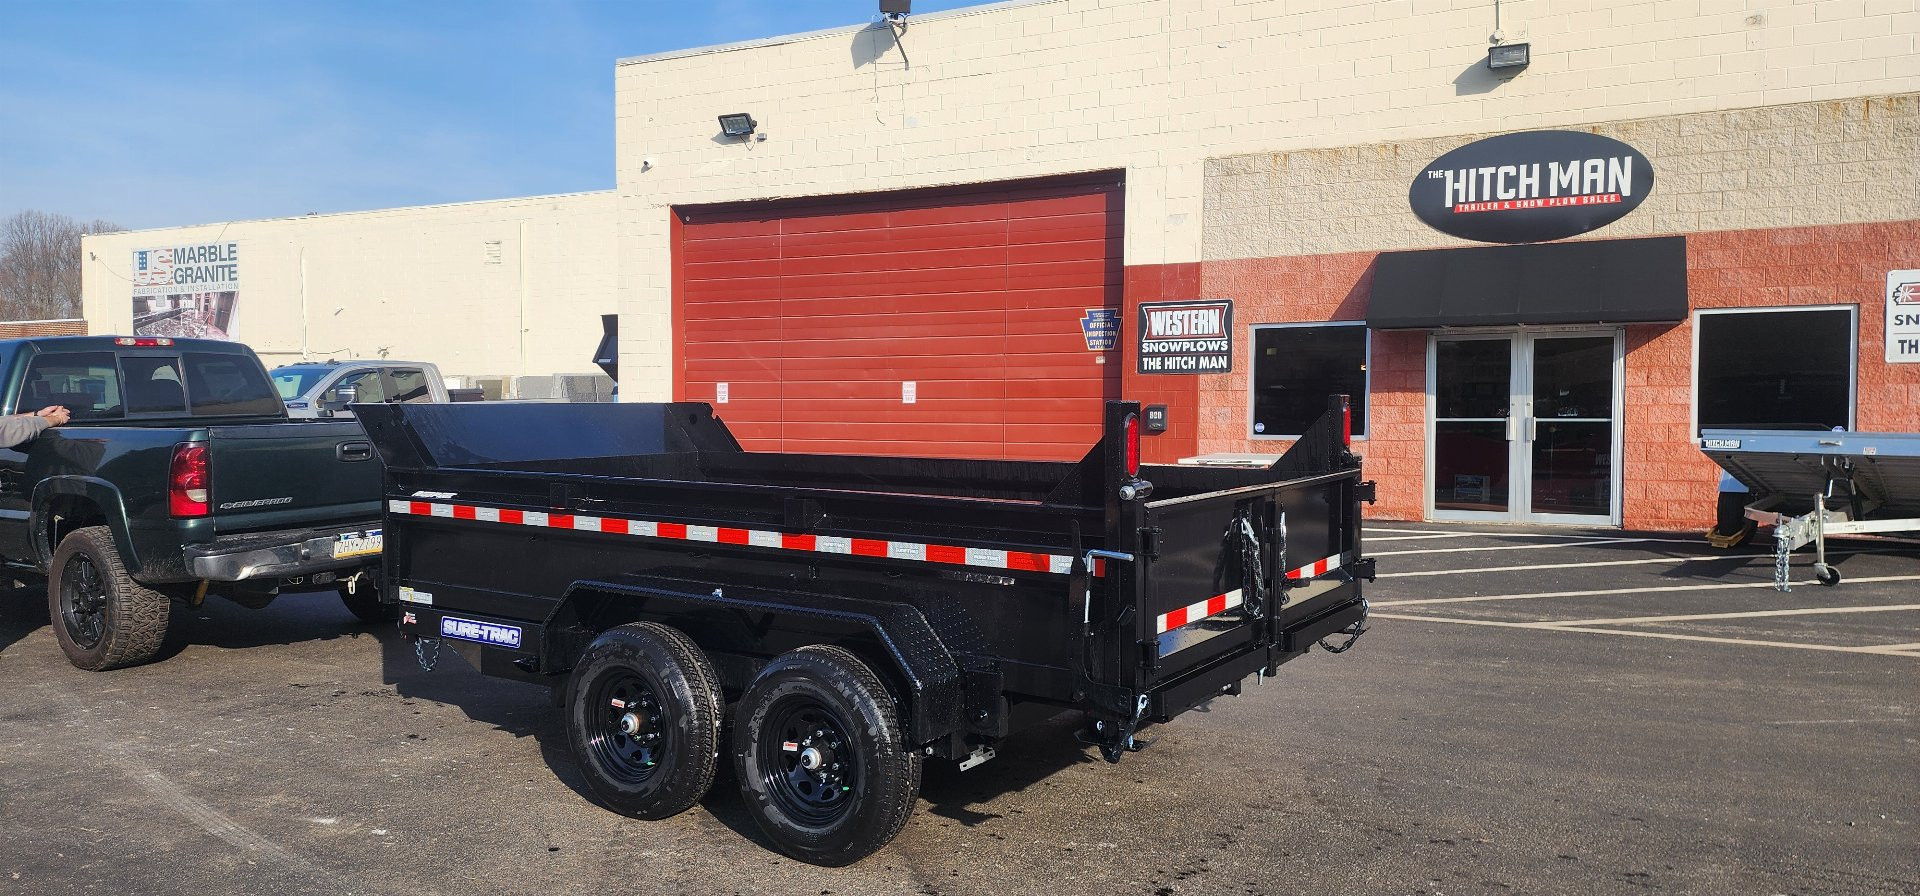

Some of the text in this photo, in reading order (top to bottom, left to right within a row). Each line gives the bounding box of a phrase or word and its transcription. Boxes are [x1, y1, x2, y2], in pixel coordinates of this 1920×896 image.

[1428, 156, 1632, 207] THE HITCH MAN
[1459, 194, 1616, 212] TRAILER & SNOW PLOW SALES
[174, 244, 237, 264] MARBLE
[133, 250, 172, 286] US
[174, 264, 238, 284] GRANITE
[133, 286, 178, 295] FABRICATION
[187, 282, 239, 292] INSTALLATION
[1150, 308, 1220, 336] WESTERN
[1894, 314, 1920, 326] SN
[1086, 330, 1117, 338] INSPECTION
[1142, 340, 1228, 353] SNOWPLOWS
[1898, 339, 1919, 354] TH
[1142, 355, 1228, 371] THE HITCH MAN
[443, 619, 519, 645] SURE-TRAC
